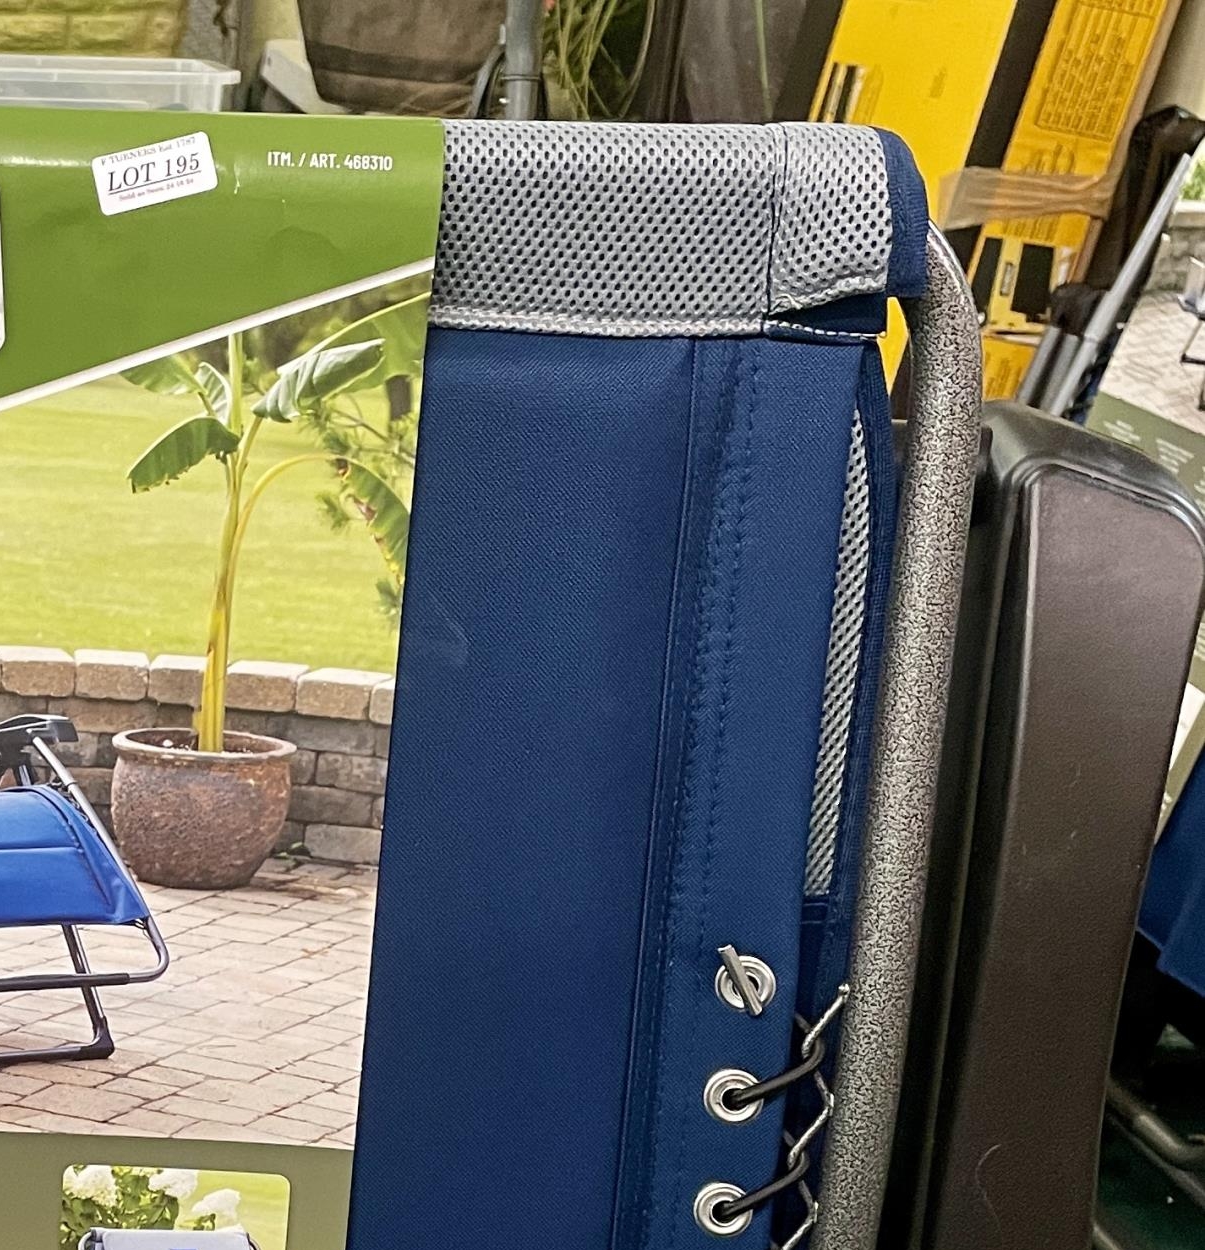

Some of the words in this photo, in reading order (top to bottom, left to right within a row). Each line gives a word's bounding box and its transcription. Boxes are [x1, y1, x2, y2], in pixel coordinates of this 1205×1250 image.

[107, 161, 156, 192] LOT
[164, 151, 200, 178] 195
[267, 151, 295, 167] ITM.
[298, 153, 307, 168] /
[309, 153, 341, 169] ART.
[343, 154, 393, 171] 468310
